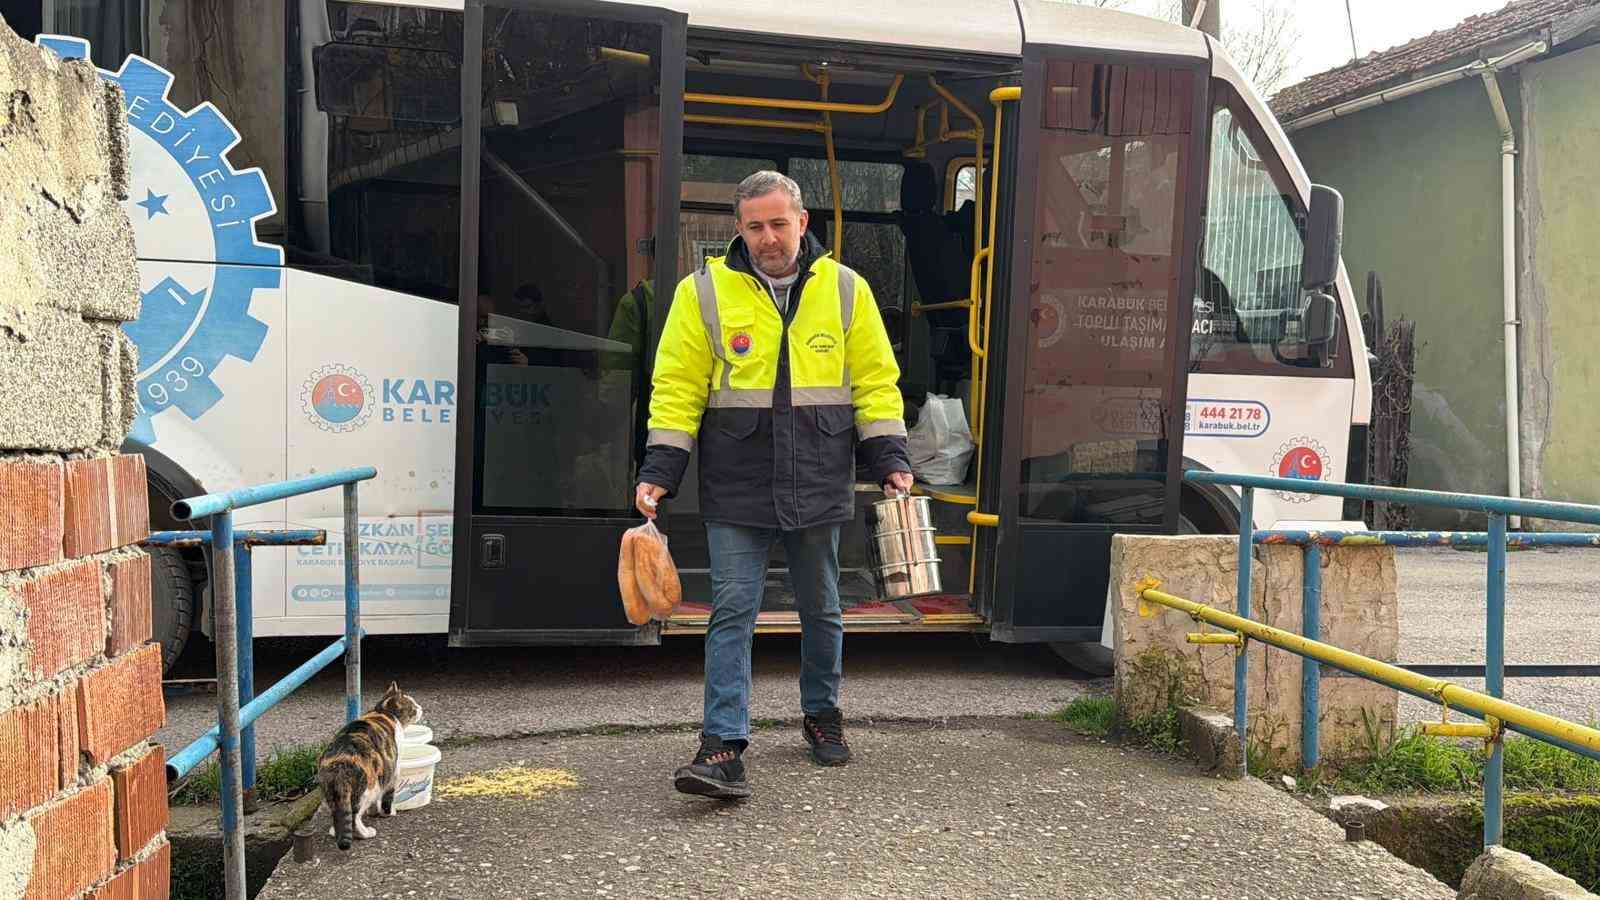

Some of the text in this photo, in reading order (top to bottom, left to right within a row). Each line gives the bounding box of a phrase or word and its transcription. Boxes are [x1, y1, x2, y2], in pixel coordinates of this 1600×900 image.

[127, 96, 245, 227] EDİYESİ
[1078, 295, 1145, 311] KARABÜK
[1101, 335, 1155, 351] ULAŞIM
[1200, 406, 1261, 421] 444 21 78
[1198, 420, 1261, 431] karabuk.bel.tr
[359, 523, 415, 537] ZKAN
